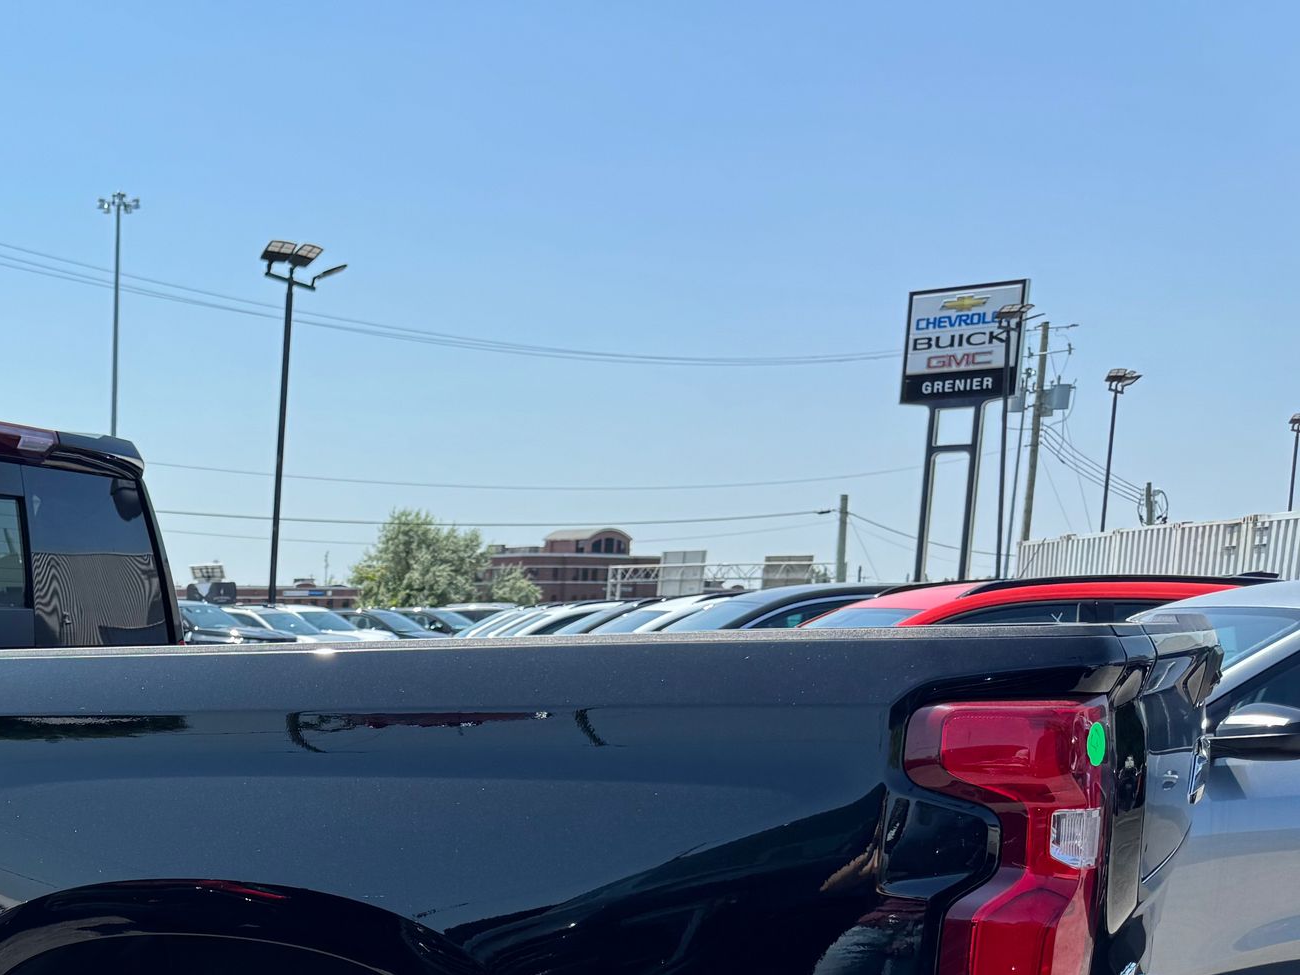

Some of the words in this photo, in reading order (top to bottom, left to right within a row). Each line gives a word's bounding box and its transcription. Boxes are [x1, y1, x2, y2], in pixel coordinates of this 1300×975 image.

[915, 311, 1001, 331] CHEVROLE
[912, 331, 1008, 351] BUICK
[926, 351, 993, 369] GMC
[921, 377, 993, 394] GRENIER
